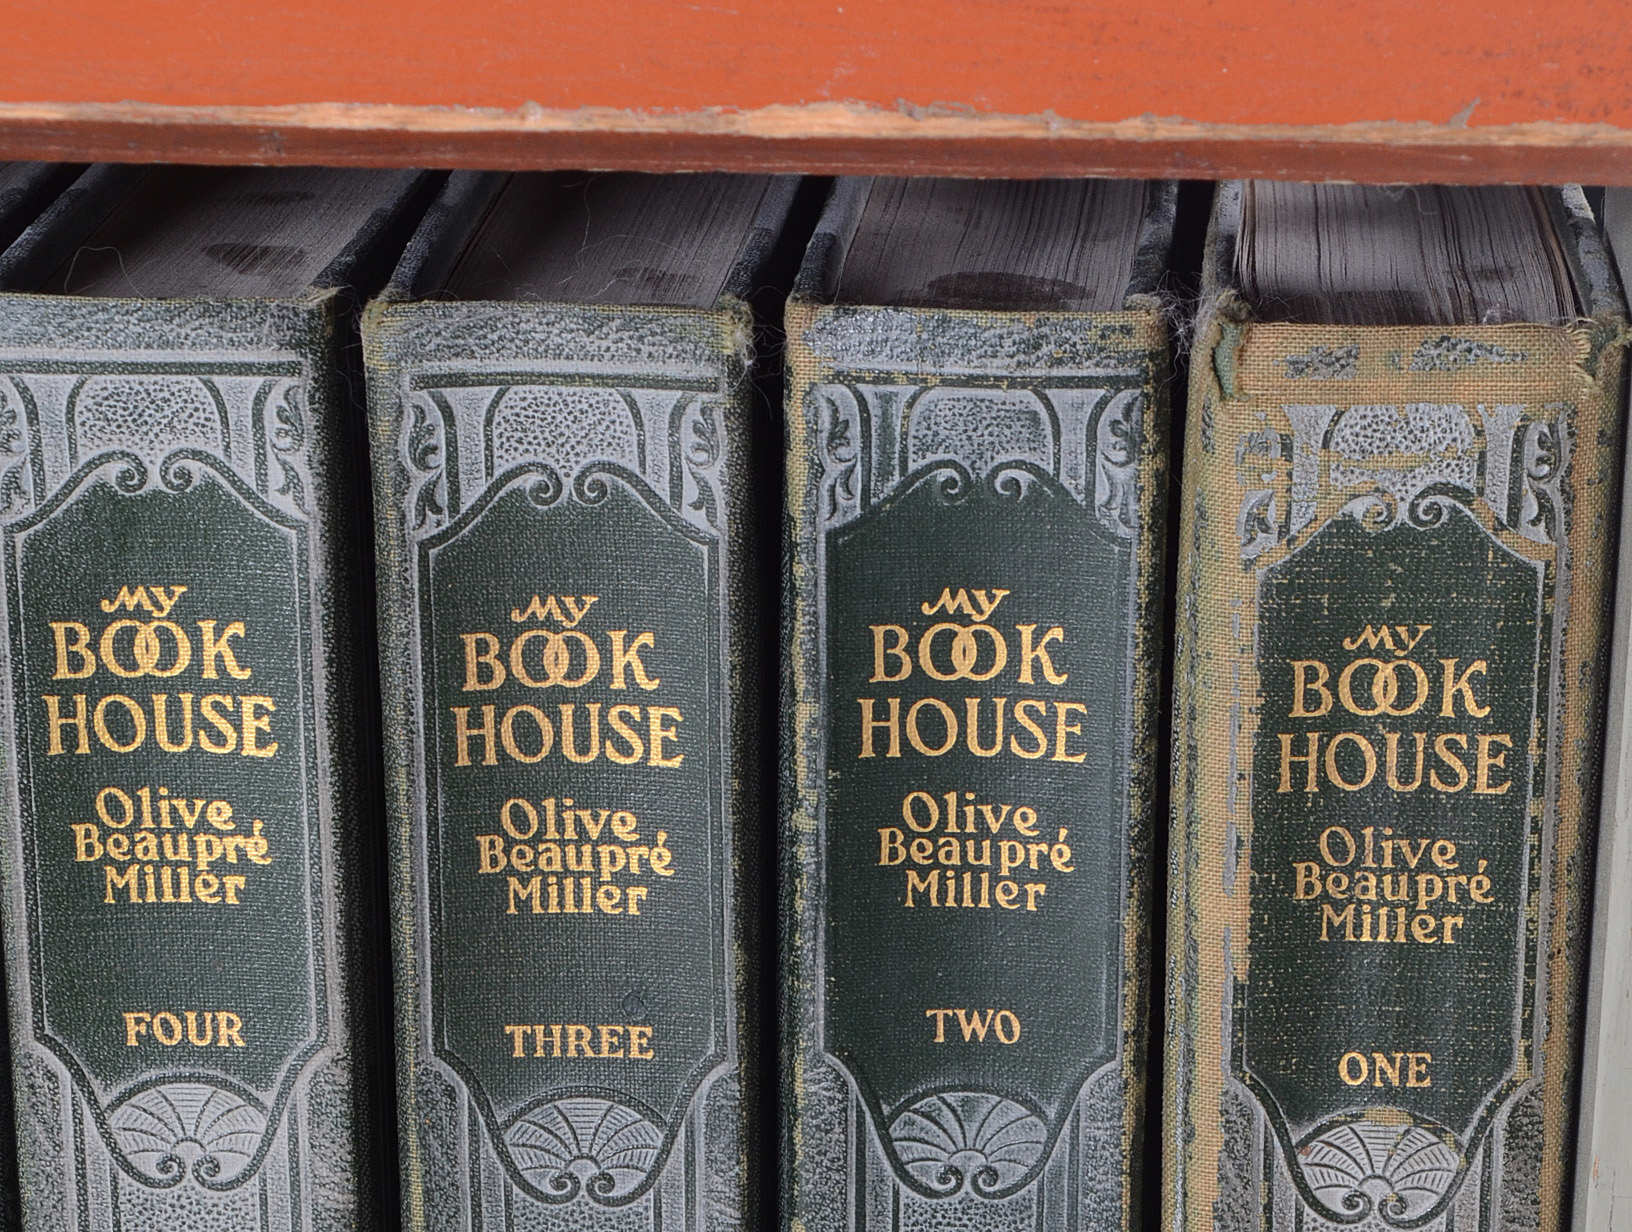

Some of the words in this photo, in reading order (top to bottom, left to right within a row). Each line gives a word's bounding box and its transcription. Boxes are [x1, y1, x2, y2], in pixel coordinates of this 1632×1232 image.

[49, 619, 251, 680] BOOK
[459, 629, 660, 691] BOOK
[868, 622, 1069, 685] BOOK
[1288, 657, 1491, 718] BOOK
[42, 693, 278, 758] HOUSE
[450, 703, 684, 768] HOUSE
[857, 697, 1088, 763] HOUSE
[1276, 732, 1513, 794] HOUSE
[95, 787, 236, 830] Olive
[501, 798, 640, 841] Olive
[902, 791, 1040, 836] Olive
[71, 820, 272, 870] Beaupré
[477, 830, 675, 881] Beaupré
[878, 827, 1075, 876] Beaupré
[1319, 826, 1458, 869] Olive
[104, 865, 246, 904] Miller
[506, 876, 647, 915] Miller
[904, 870, 1046, 911] Miller
[1293, 859, 1495, 910] Beaupré
[1319, 903, 1463, 944] Miller
[125, 1011, 246, 1046] FOUR
[505, 1025, 654, 1059] THREE
[926, 1009, 1022, 1044] TWO
[1339, 1051, 1431, 1087] ONE
